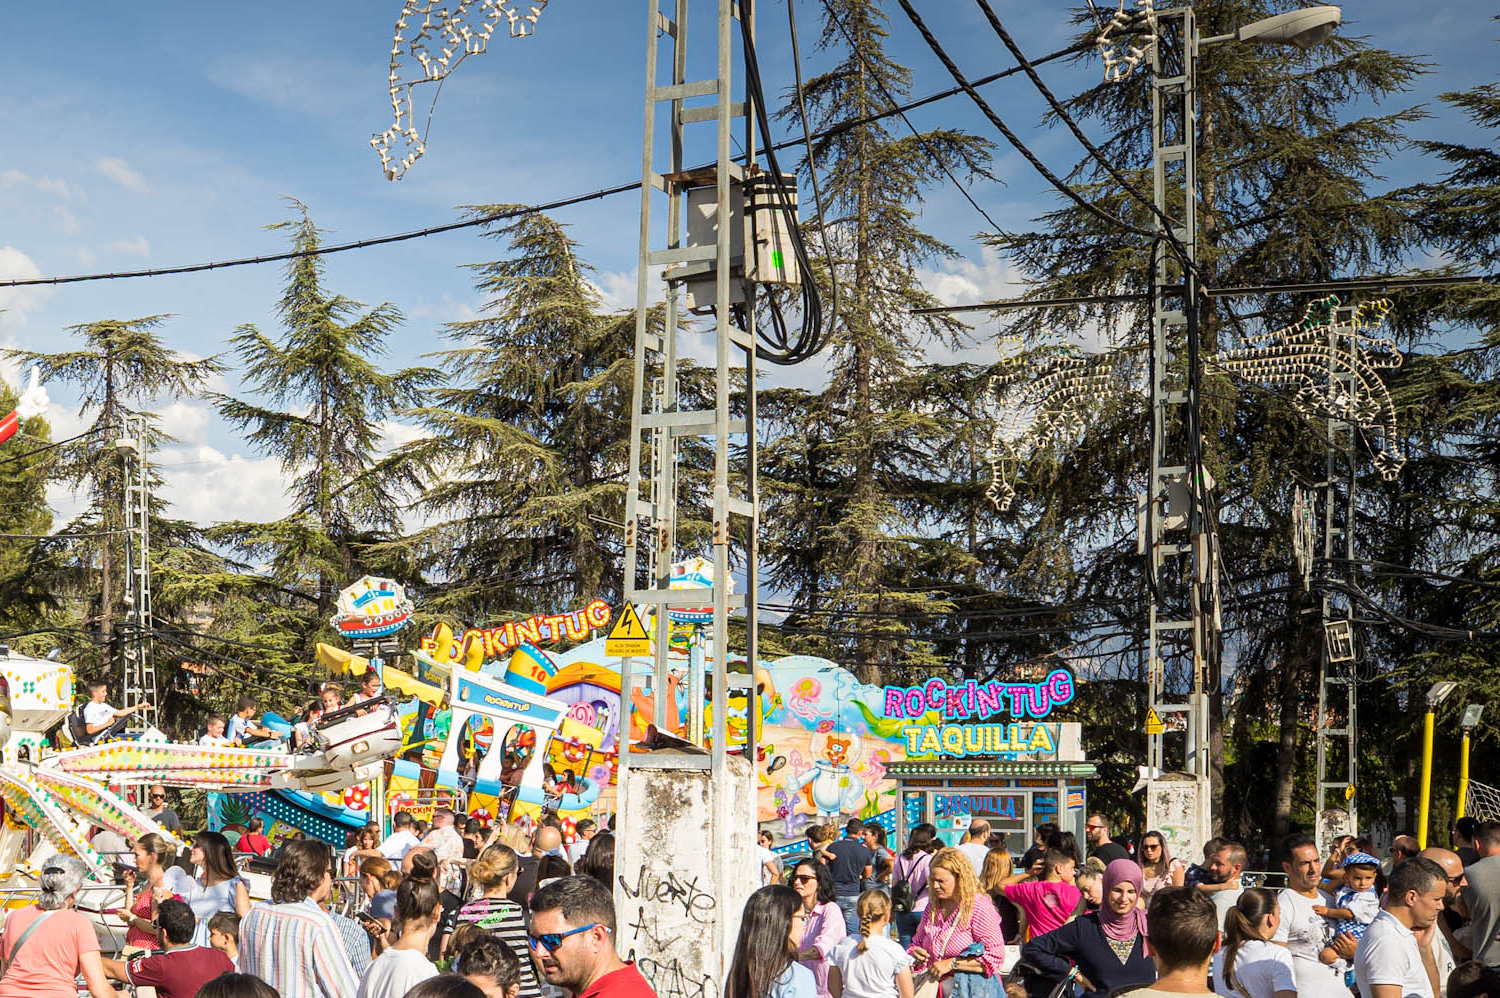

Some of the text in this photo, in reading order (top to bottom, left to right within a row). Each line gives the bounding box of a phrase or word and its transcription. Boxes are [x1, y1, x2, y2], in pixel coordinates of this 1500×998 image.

[530, 665, 547, 682] 10
[904, 725, 1053, 755] TAQUILLA
[942, 796, 1017, 821] TAQUILLA
